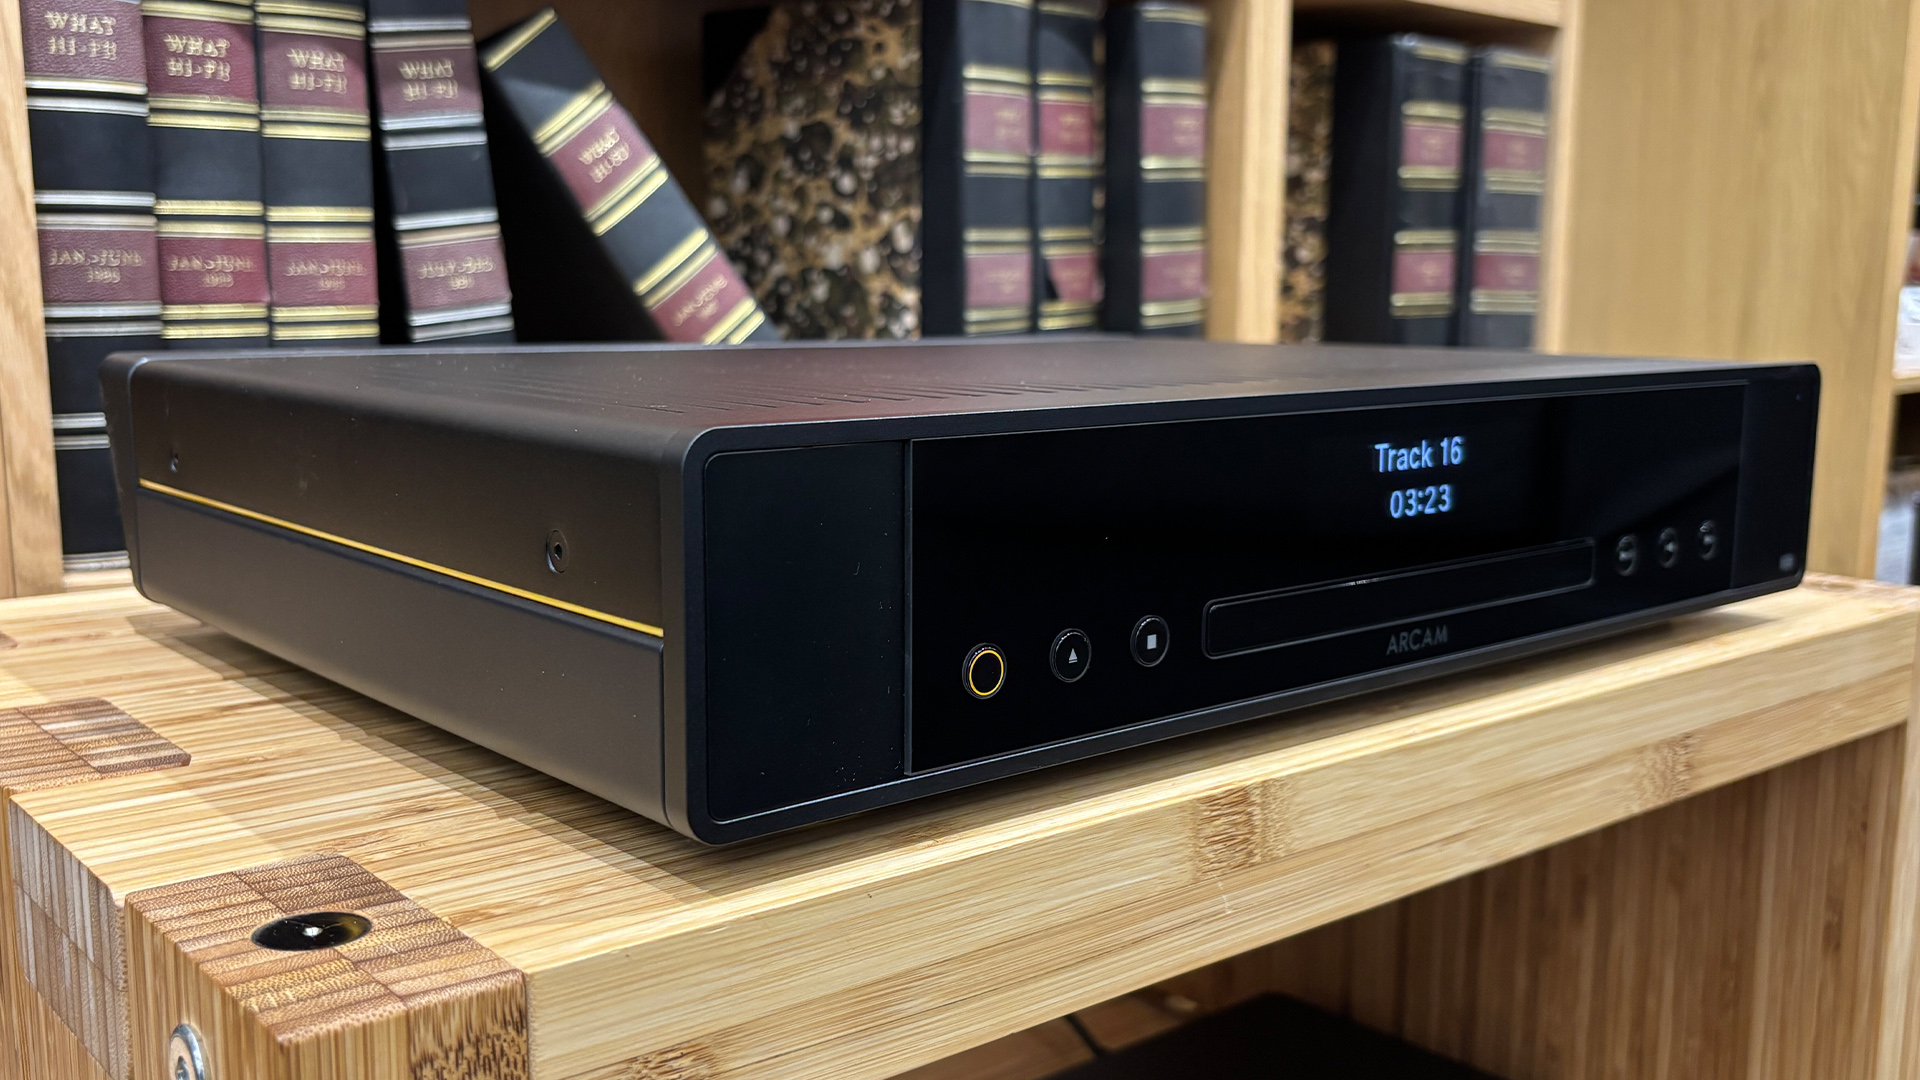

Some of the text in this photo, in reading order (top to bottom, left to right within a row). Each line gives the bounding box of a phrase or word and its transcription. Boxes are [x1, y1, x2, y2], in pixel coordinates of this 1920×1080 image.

[44, 10, 117, 36] WHAT
[163, 32, 231, 58] WHAT
[286, 48, 347, 73] WHAT
[399, 57, 454, 80] WHAT
[1374, 435, 1464, 473] Track 16
[1390, 484, 1451, 519] 03:23
[1386, 624, 1448, 656] ARCAM
